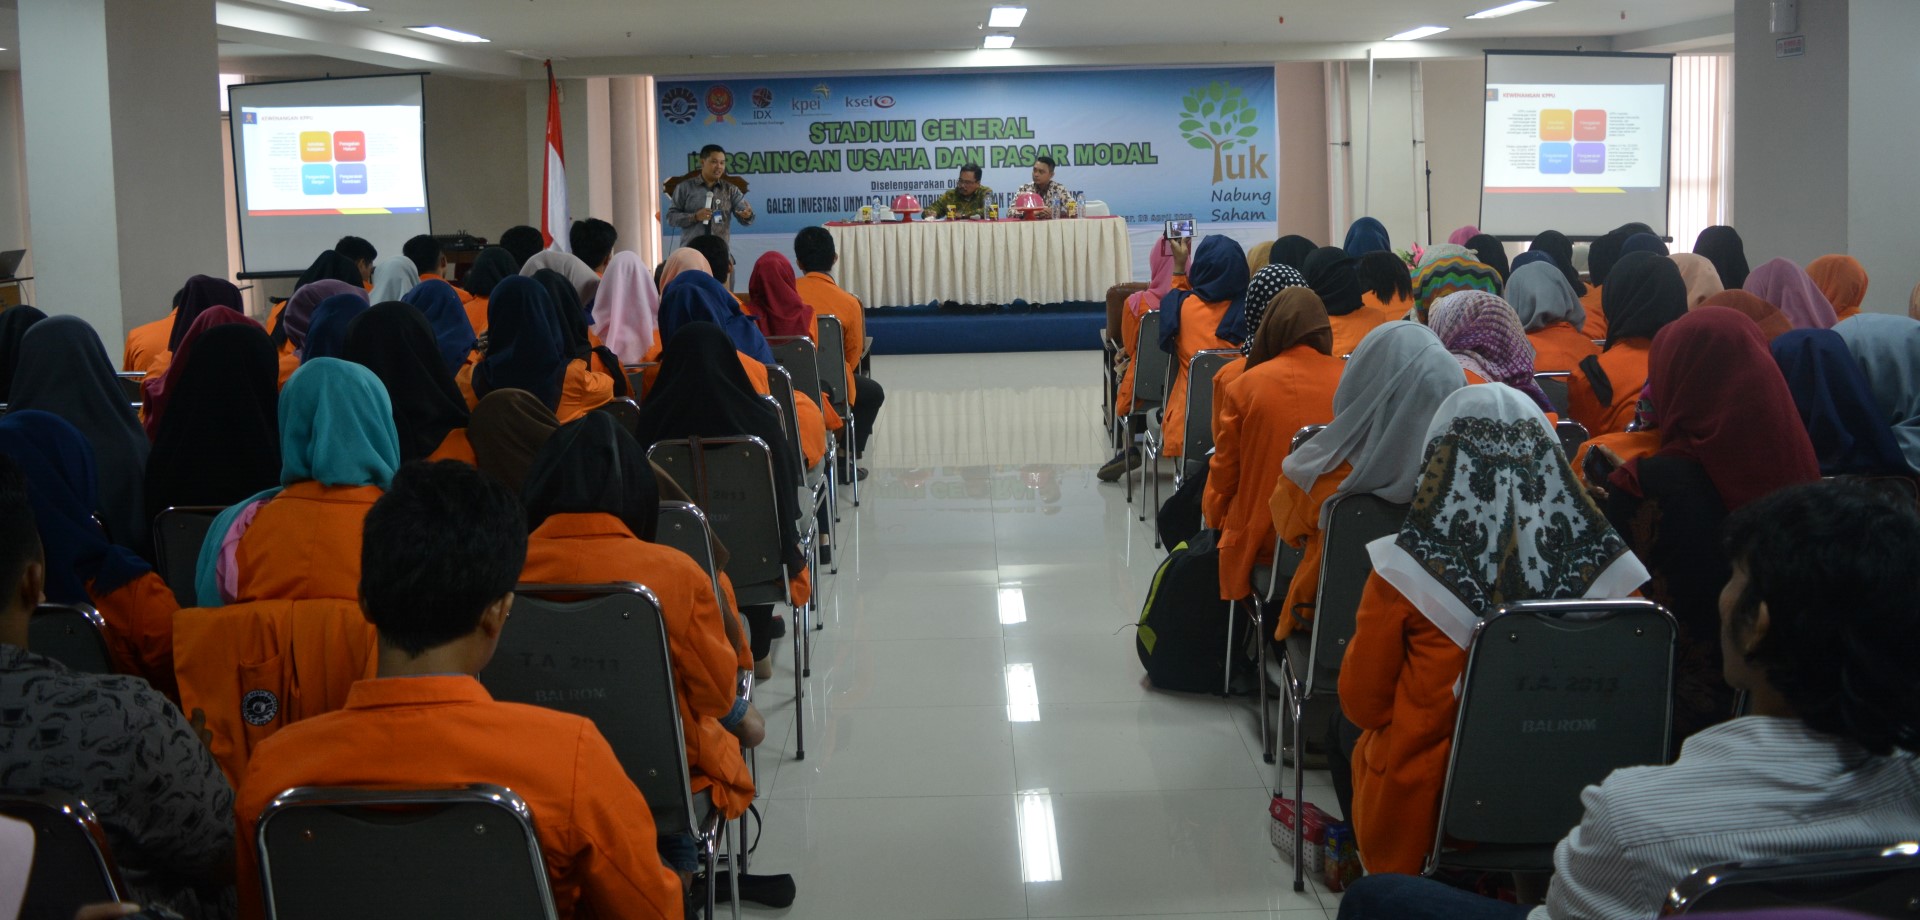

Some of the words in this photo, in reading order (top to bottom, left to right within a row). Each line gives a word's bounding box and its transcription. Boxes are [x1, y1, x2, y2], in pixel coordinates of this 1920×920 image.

[792, 97, 820, 114] kpei
[846, 95, 873, 108] ksei
[753, 110, 772, 119] IDX
[809, 119, 917, 145] STADIUM
[921, 116, 1035, 141] GENERAL
[688, 149, 841, 175] PRSAINGAN
[846, 147, 932, 171] USAHA
[935, 145, 985, 169] DAN
[990, 144, 1070, 168] PASAR
[1074, 142, 1158, 166] MODAL
[871, 180, 944, 191] Diselenggarakan
[766, 197, 795, 214] GALERI
[798, 195, 841, 213] INVESTASI
[843, 194, 863, 212] UNM
[1211, 187, 1271, 206] Nabung
[1211, 207, 1266, 222] Saham
[1521, 718, 1597, 734] BALROM
